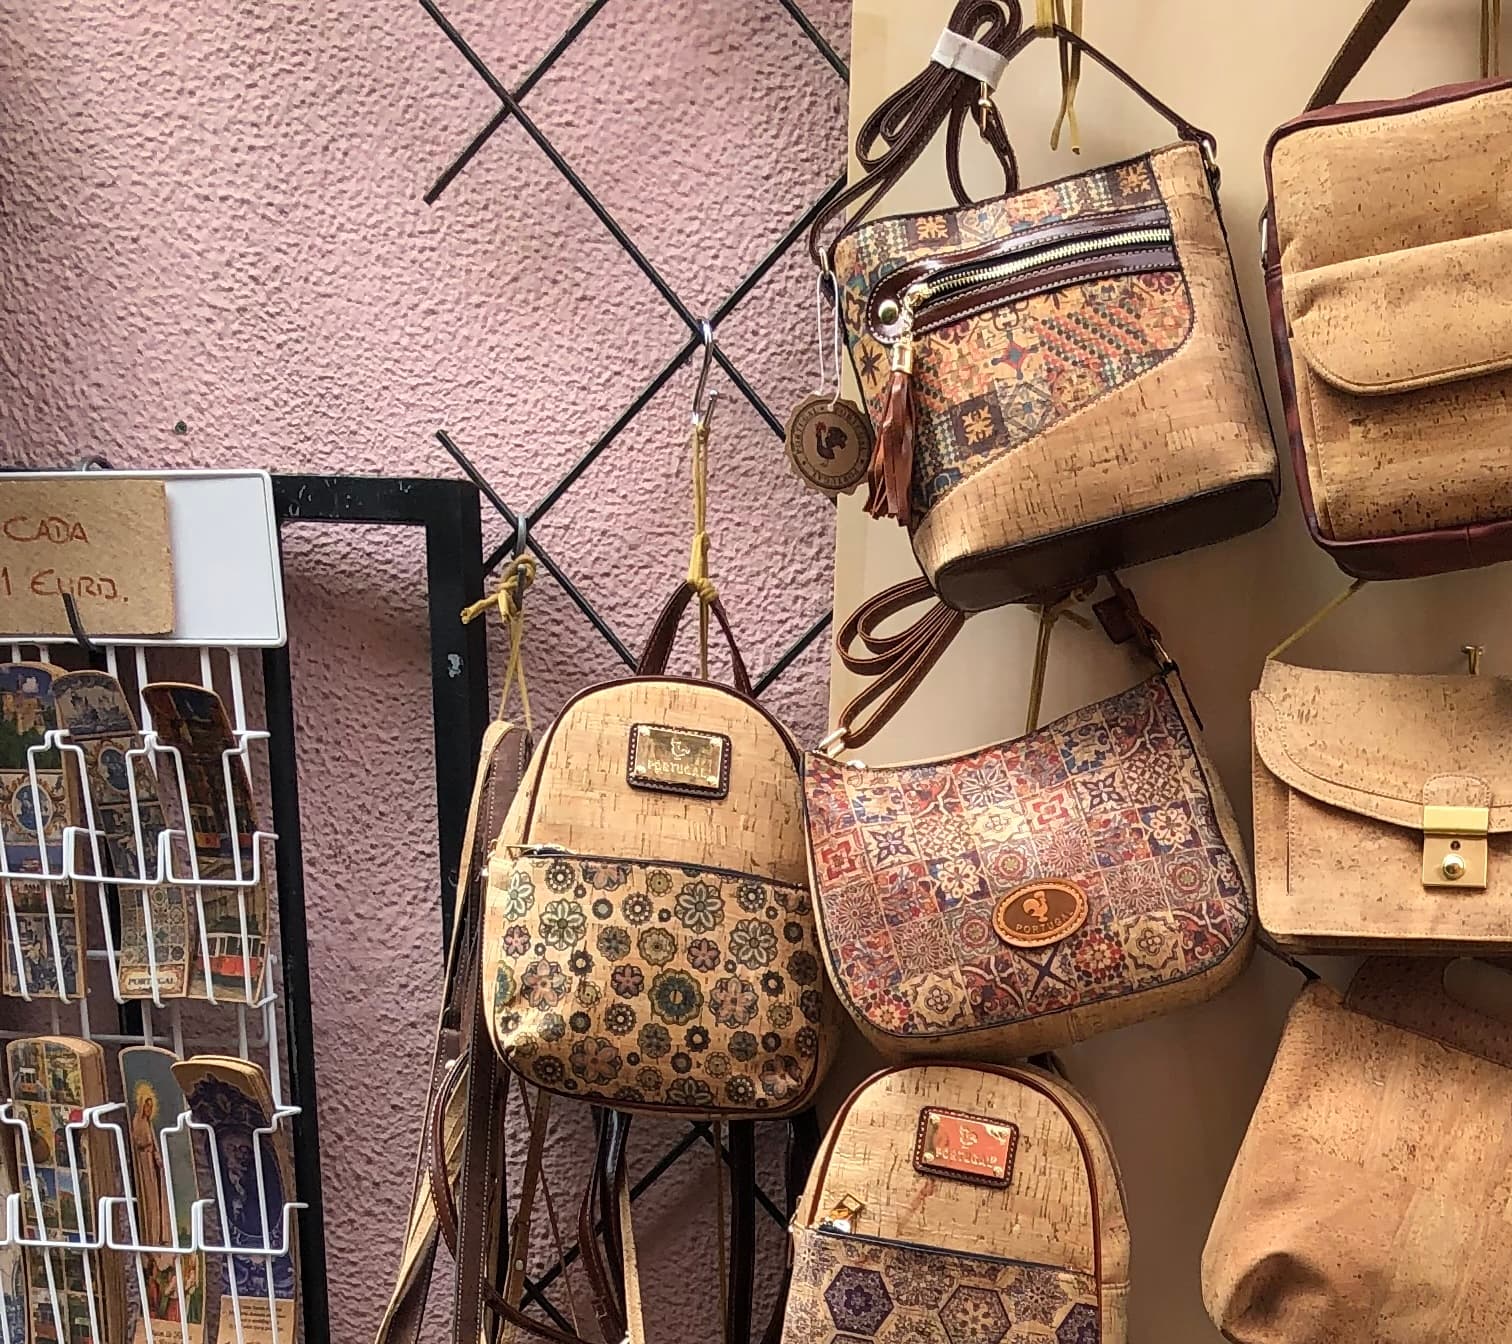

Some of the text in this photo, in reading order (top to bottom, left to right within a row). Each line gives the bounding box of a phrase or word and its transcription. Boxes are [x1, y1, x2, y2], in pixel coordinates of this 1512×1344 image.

[3, 516, 89, 544] CADA
[0, 566, 12, 596] 1
[647, 759, 707, 779] PORTUGAL
[1015, 911, 1074, 934] PORTUGAL
